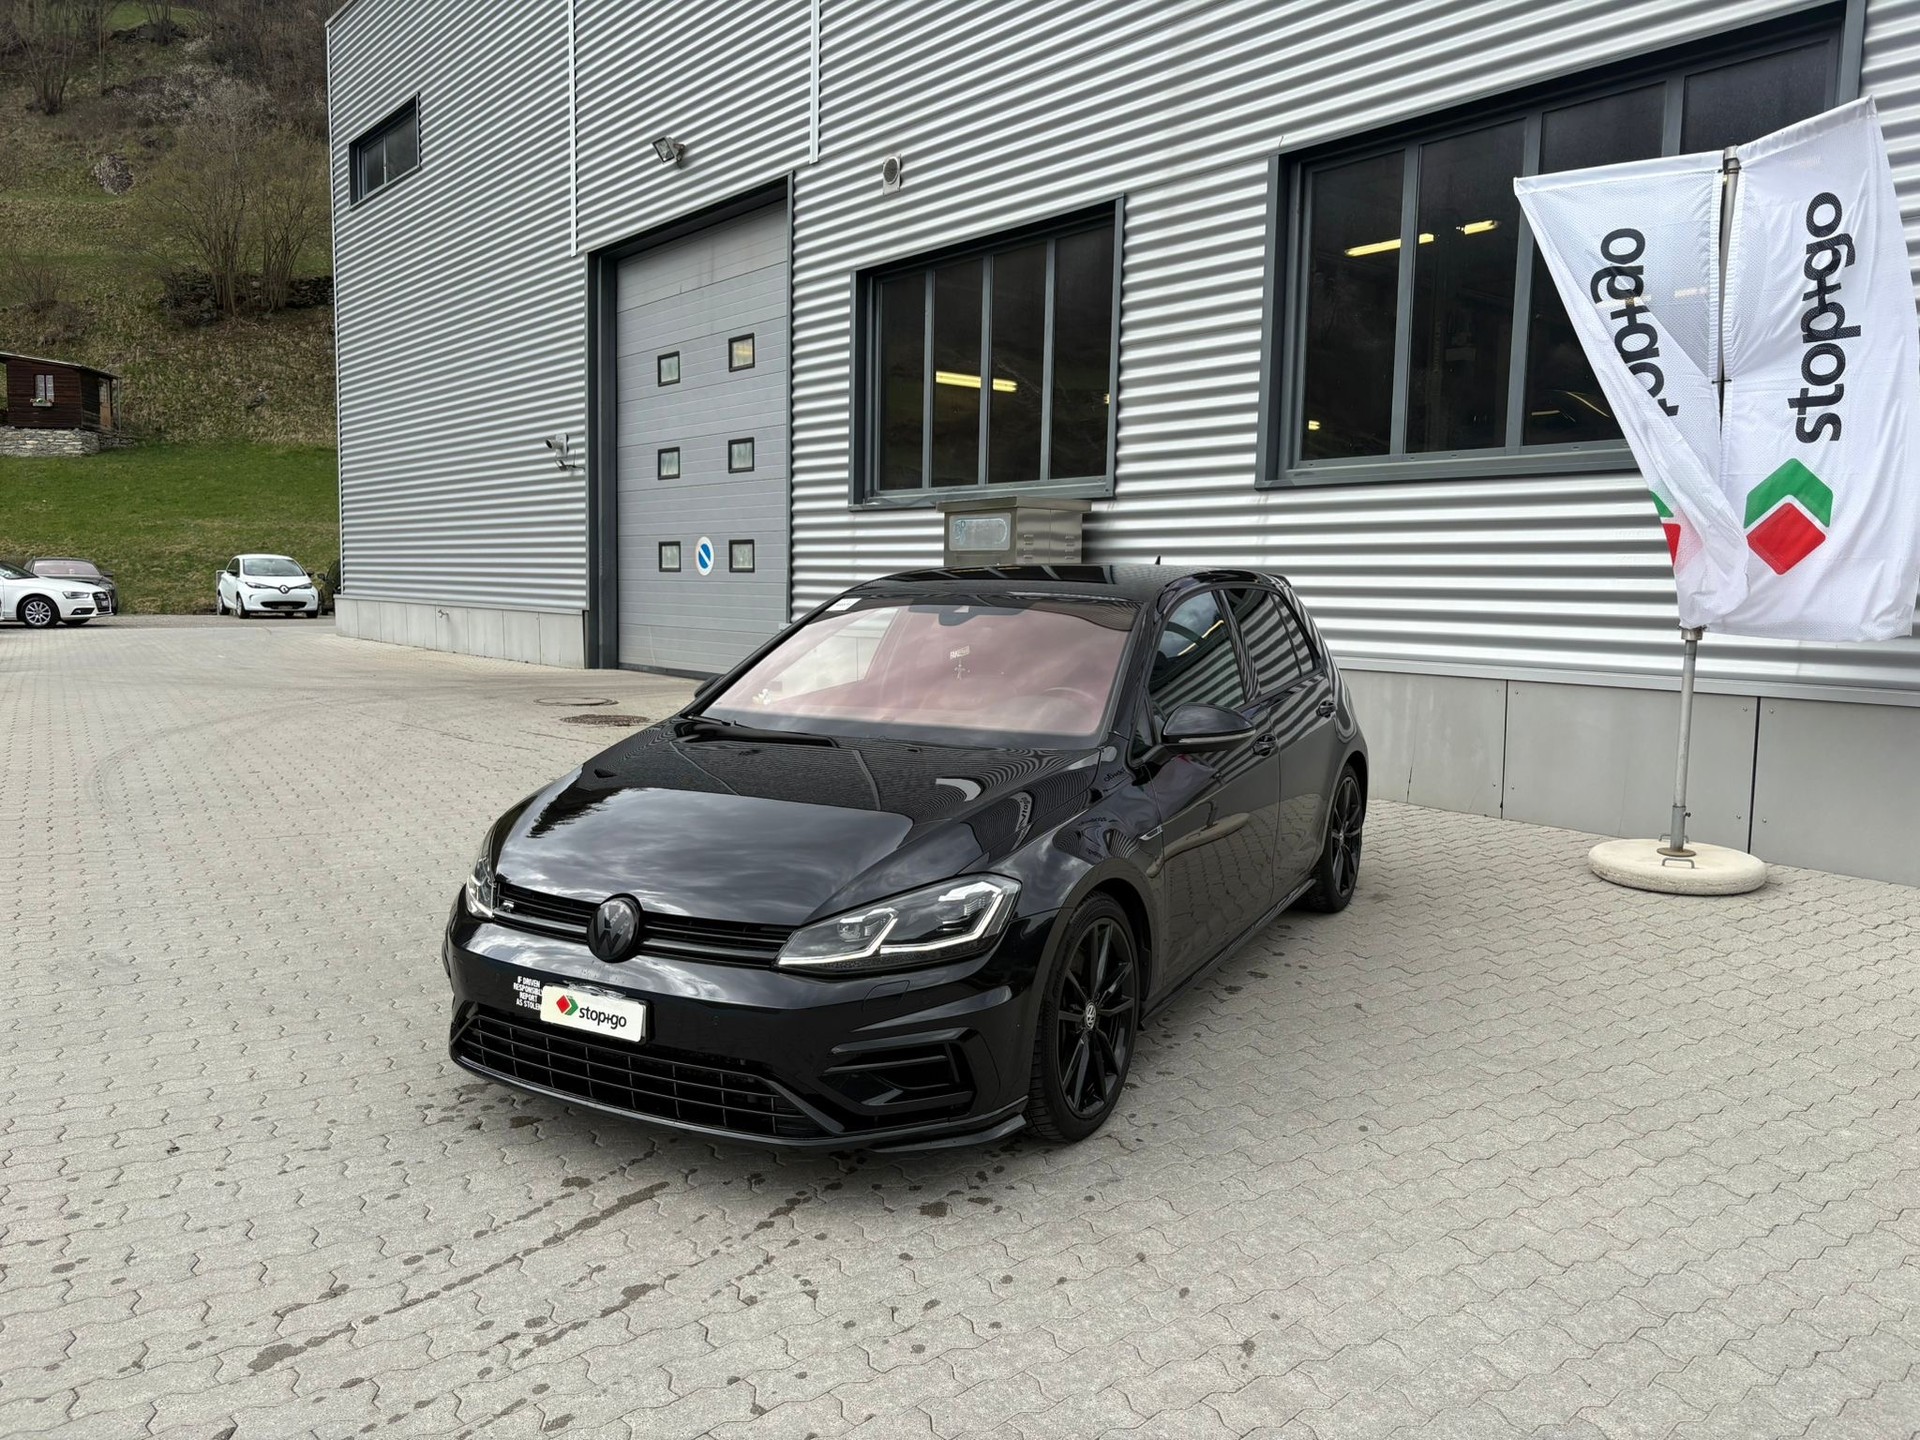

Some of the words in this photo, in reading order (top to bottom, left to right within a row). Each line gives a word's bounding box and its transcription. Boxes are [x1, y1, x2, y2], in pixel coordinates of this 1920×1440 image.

[1787, 191, 1862, 444] stop+go
[522, 977, 541, 988] DRIVEN
[516, 998, 523, 1007] AS
[519, 991, 538, 1003] REPORT
[578, 1006, 627, 1030] stop+go
